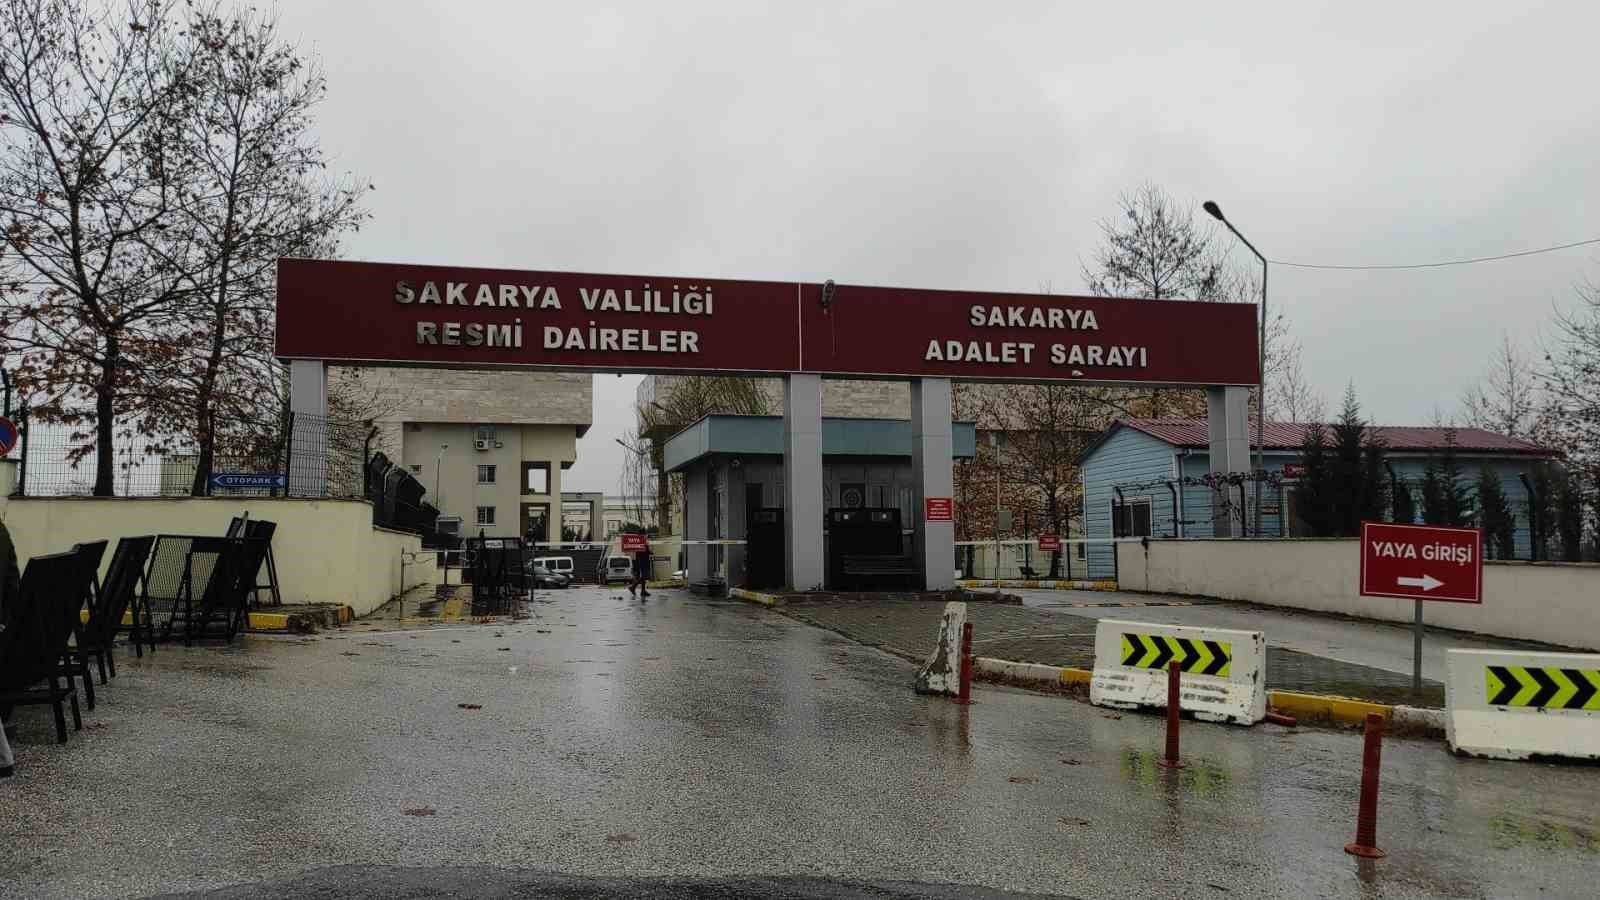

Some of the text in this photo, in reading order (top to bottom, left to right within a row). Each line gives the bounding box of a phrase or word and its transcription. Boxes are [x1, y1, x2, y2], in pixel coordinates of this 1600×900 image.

[394, 280, 713, 315] SAKARYA VALİLİĞİ
[970, 305, 1099, 329] SAKARYA
[416, 318, 699, 353] RESMİ DAİRELER
[925, 340, 1148, 367] ADALET SARAYI
[1372, 541, 1472, 566] YAYA GİRİŞİ
